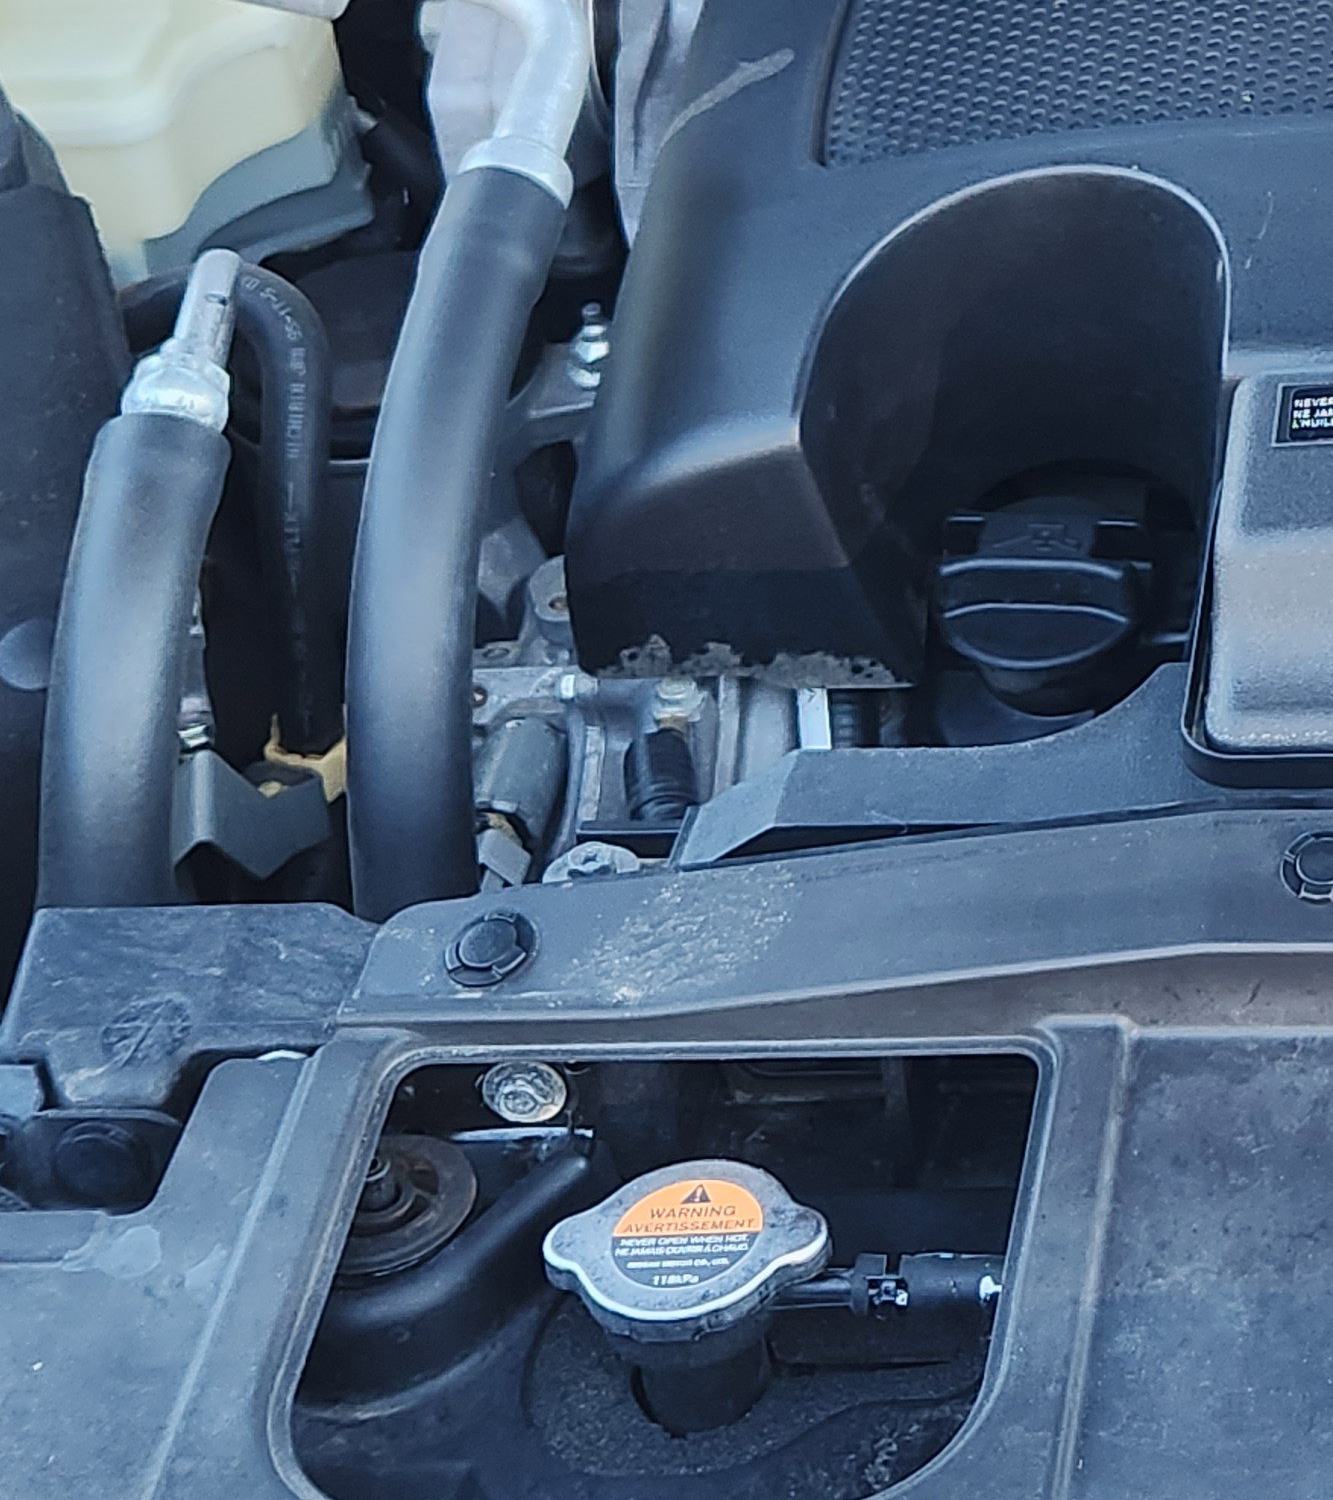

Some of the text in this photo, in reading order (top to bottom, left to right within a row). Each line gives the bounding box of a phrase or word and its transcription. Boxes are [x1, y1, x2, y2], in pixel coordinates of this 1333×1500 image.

[1293, 409, 1311, 419] NE
[650, 1205, 736, 1219] WARNING
[623, 1218, 756, 1233] AVERTISSEMENT
[620, 1237, 656, 1247] NEVER
[658, 1236, 689, 1246] OPEN
[690, 1235, 724, 1244] WHEN
